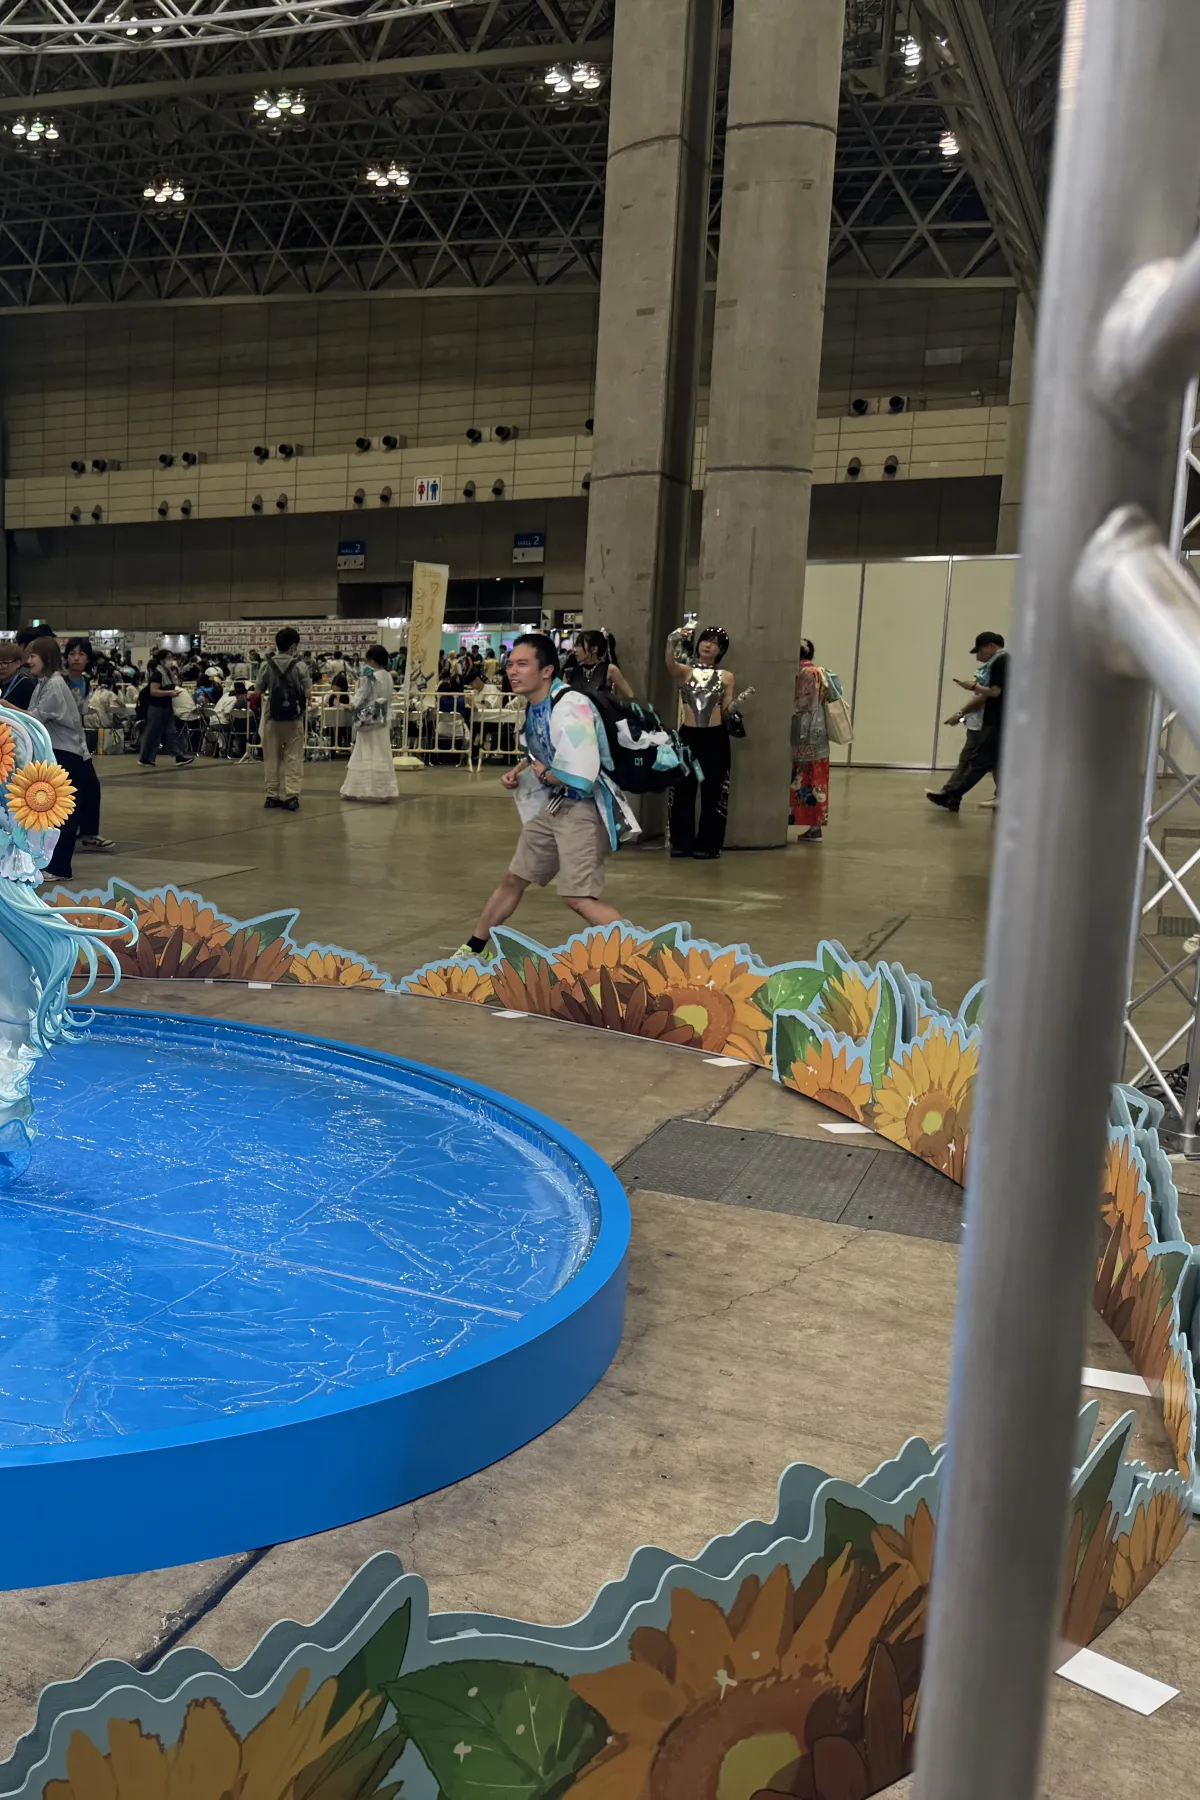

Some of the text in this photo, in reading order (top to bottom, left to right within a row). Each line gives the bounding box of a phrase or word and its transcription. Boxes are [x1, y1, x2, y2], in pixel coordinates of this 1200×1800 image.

[533, 535, 540, 545] 2
[355, 543, 361, 553] 2
[425, 582, 440, 629] ワーク
